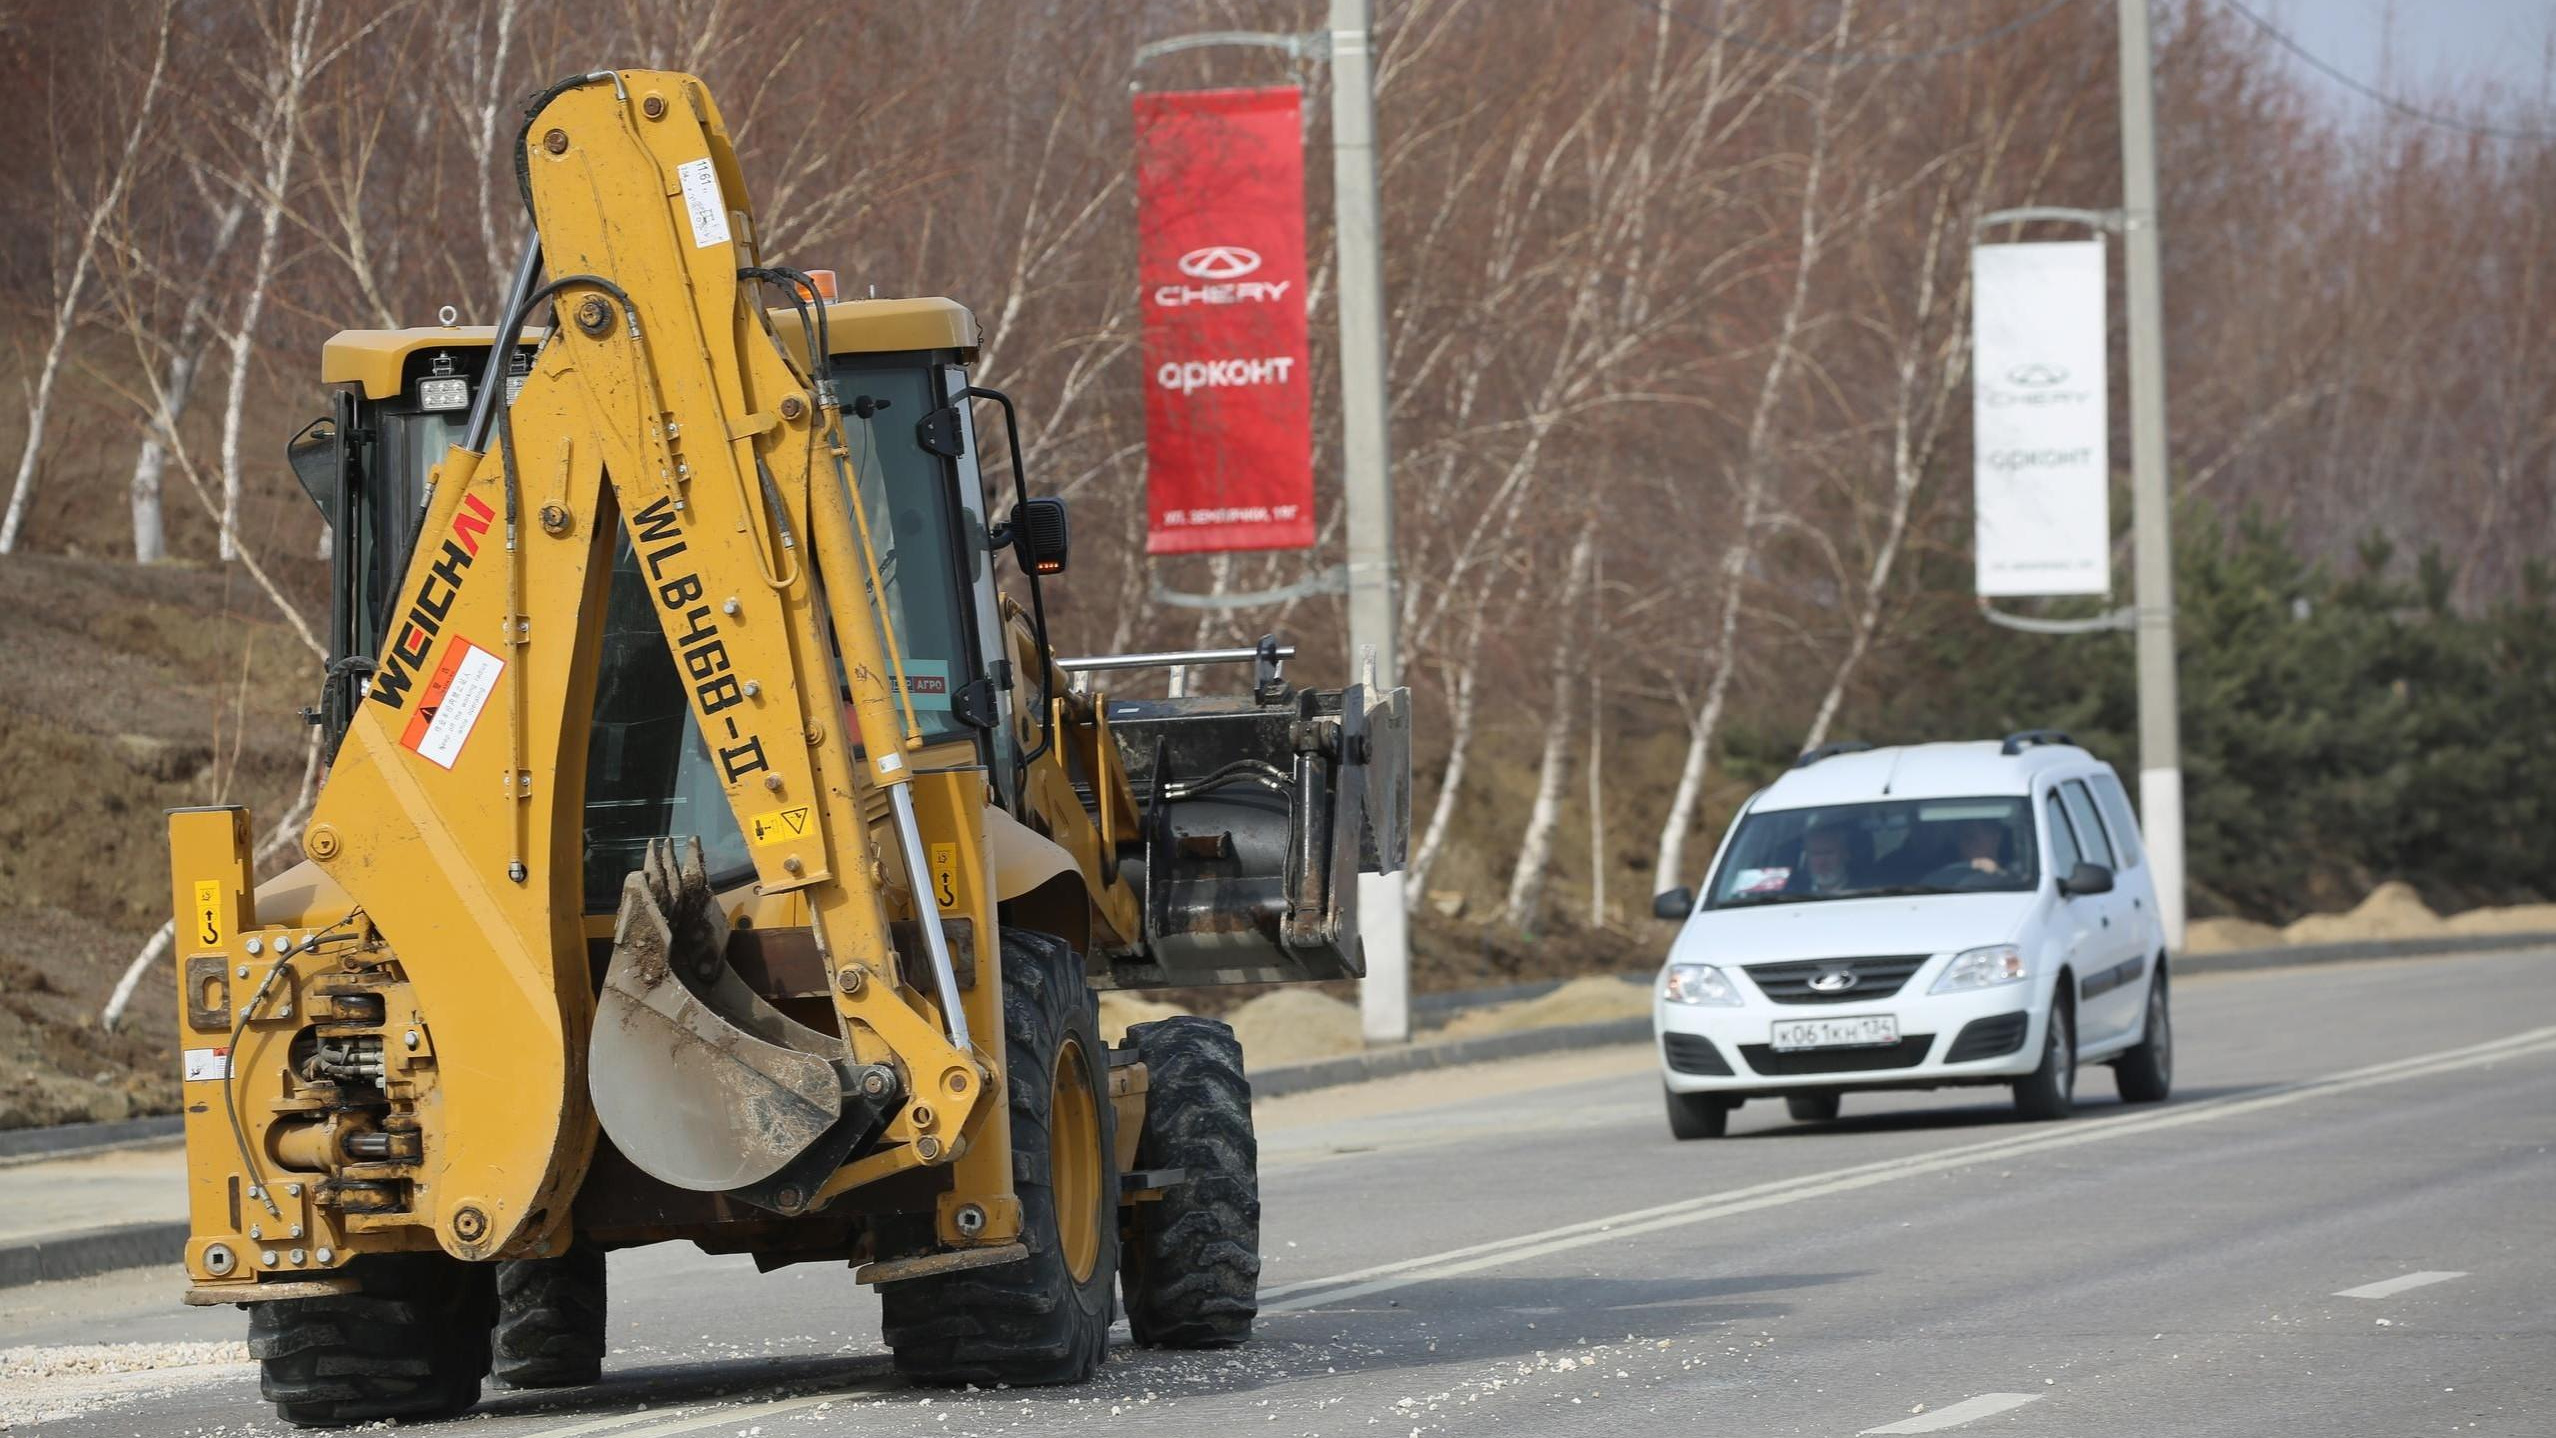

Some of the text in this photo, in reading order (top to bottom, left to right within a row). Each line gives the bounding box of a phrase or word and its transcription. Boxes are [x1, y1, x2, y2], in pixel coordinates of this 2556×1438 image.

[1155, 280, 1291, 306] CHERY
[1158, 357, 1295, 395] арконт
[370, 493, 496, 710] WEICHAI
[917, 680, 943, 691] АГРО
